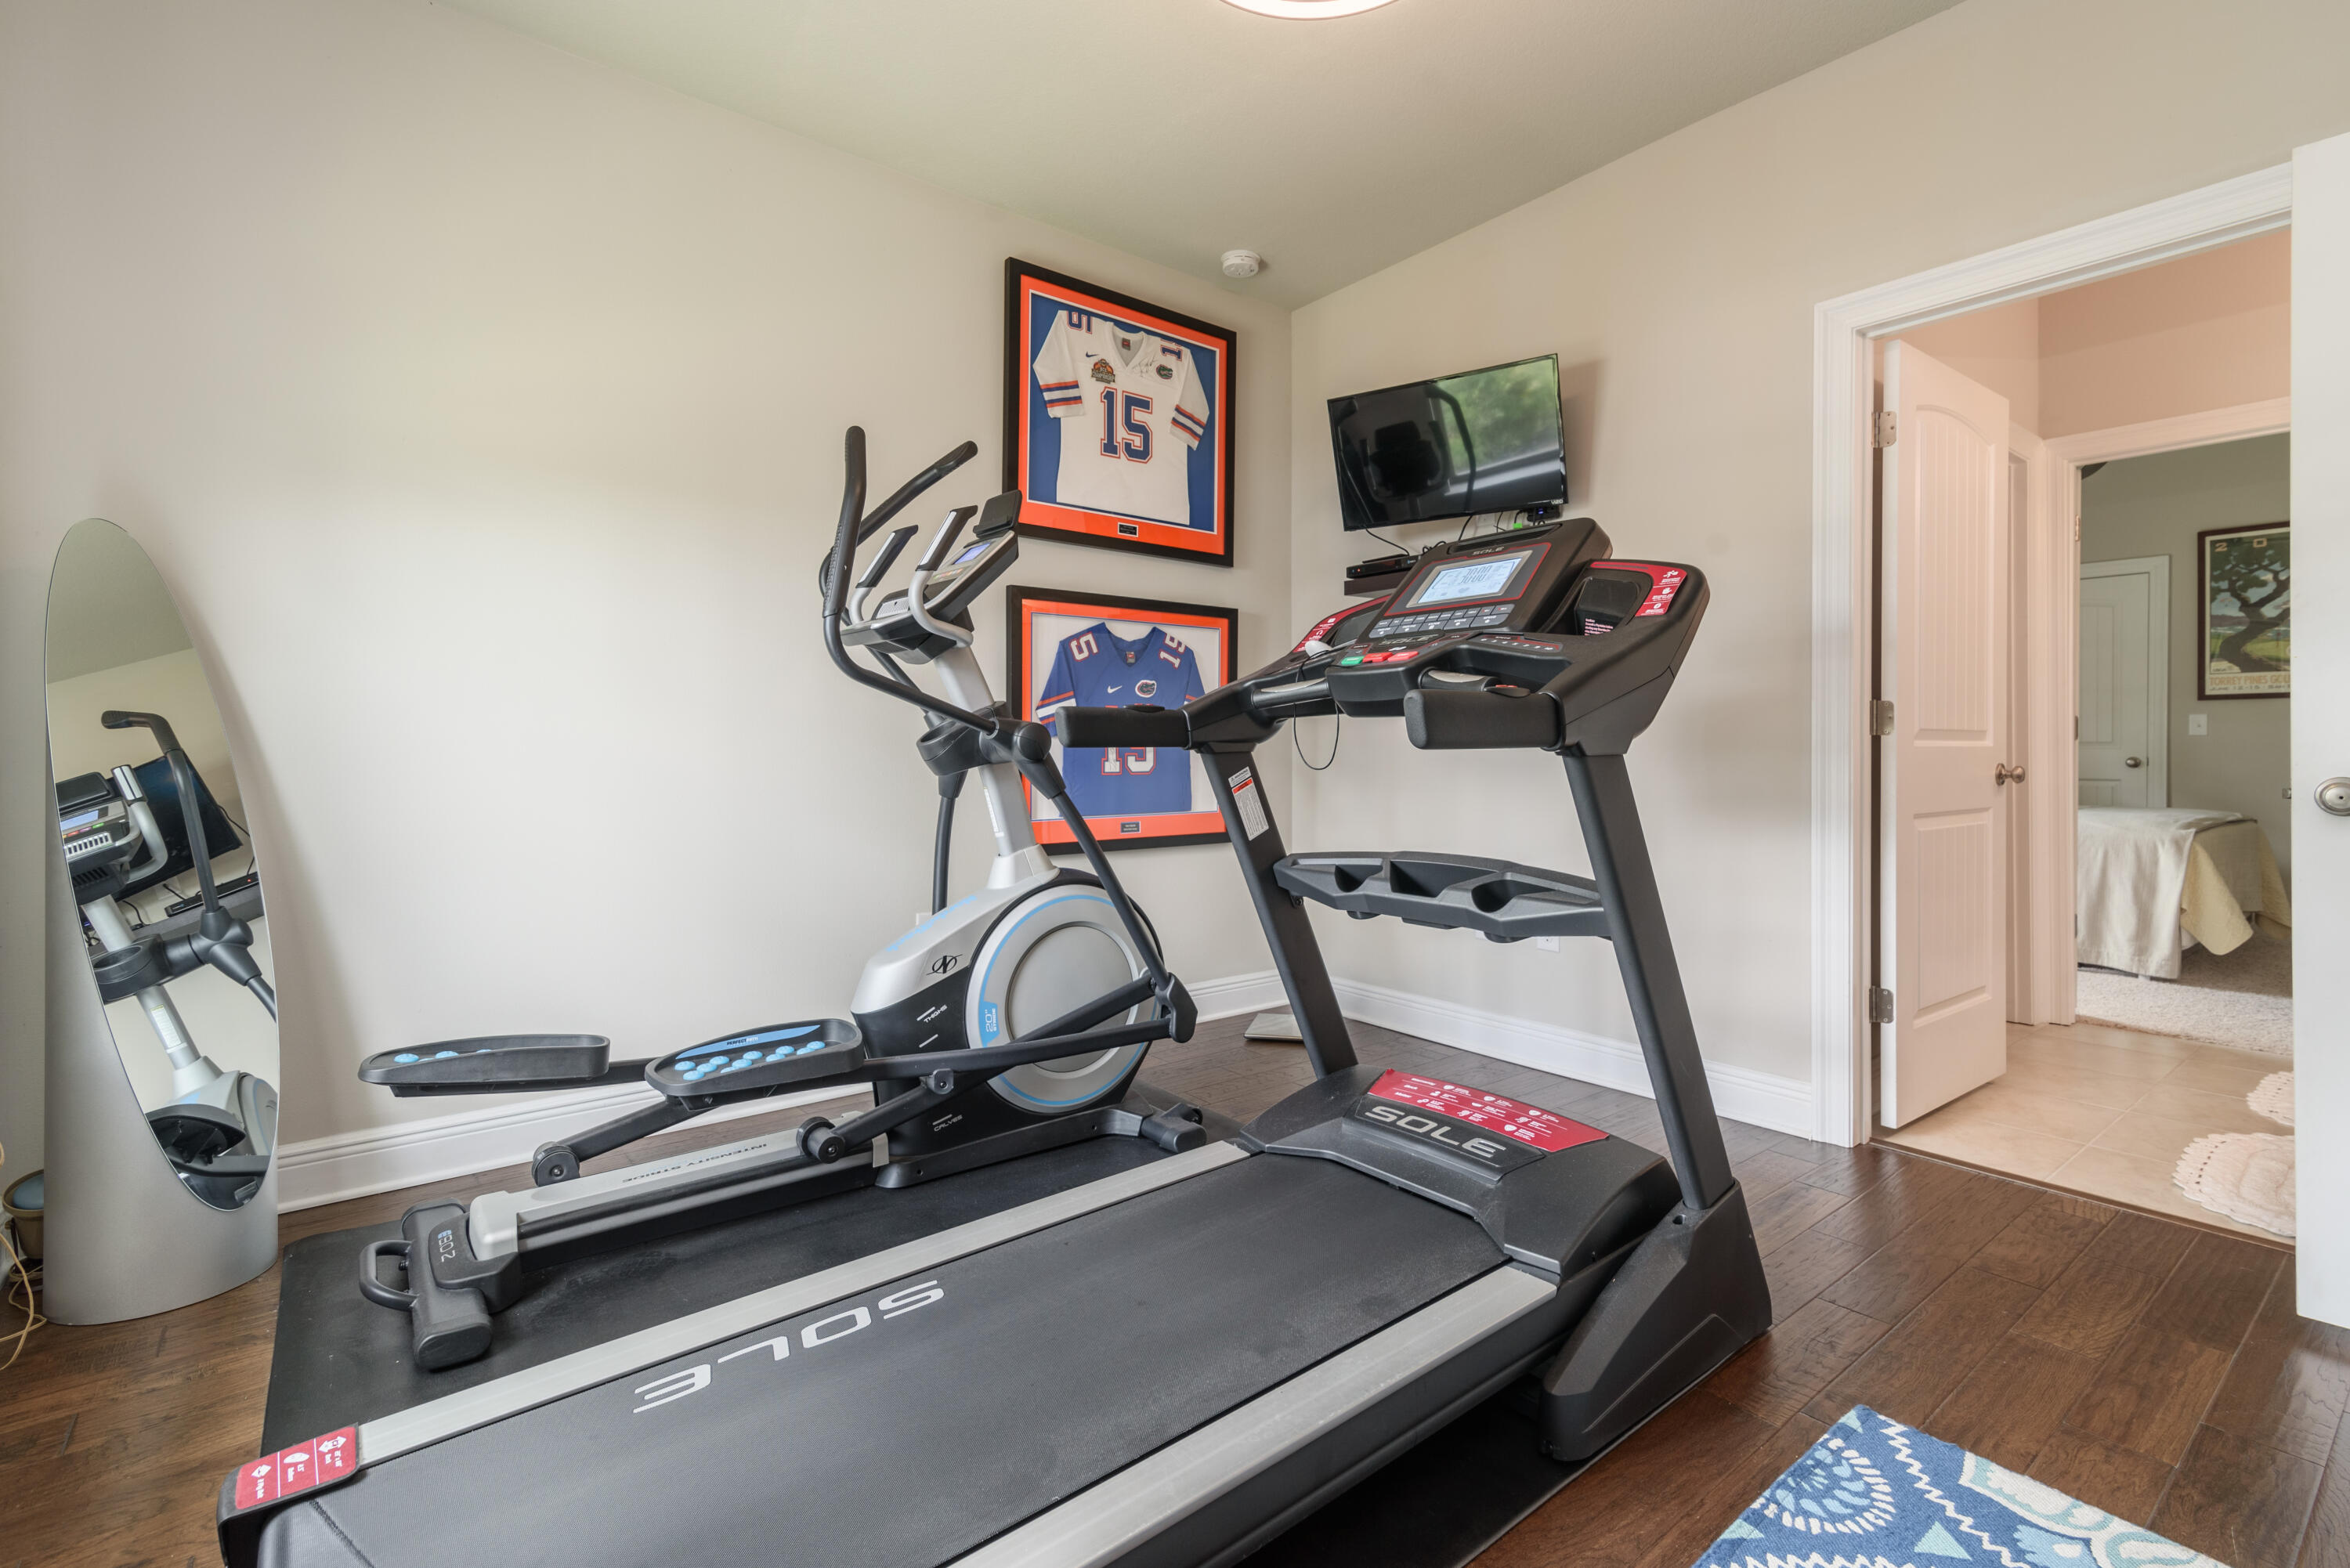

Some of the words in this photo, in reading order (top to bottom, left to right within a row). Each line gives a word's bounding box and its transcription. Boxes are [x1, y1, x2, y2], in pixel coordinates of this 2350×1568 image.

[1101, 386, 1153, 464] 15
[2214, 542, 2228, 552] 2
[1069, 631, 1099, 663] 5
[924, 1004, 948, 1023] THIGHS
[934, 1115, 963, 1132] CALVES
[1365, 1105, 1506, 1158] SOLE
[633, 1280, 945, 1414] SOLE
